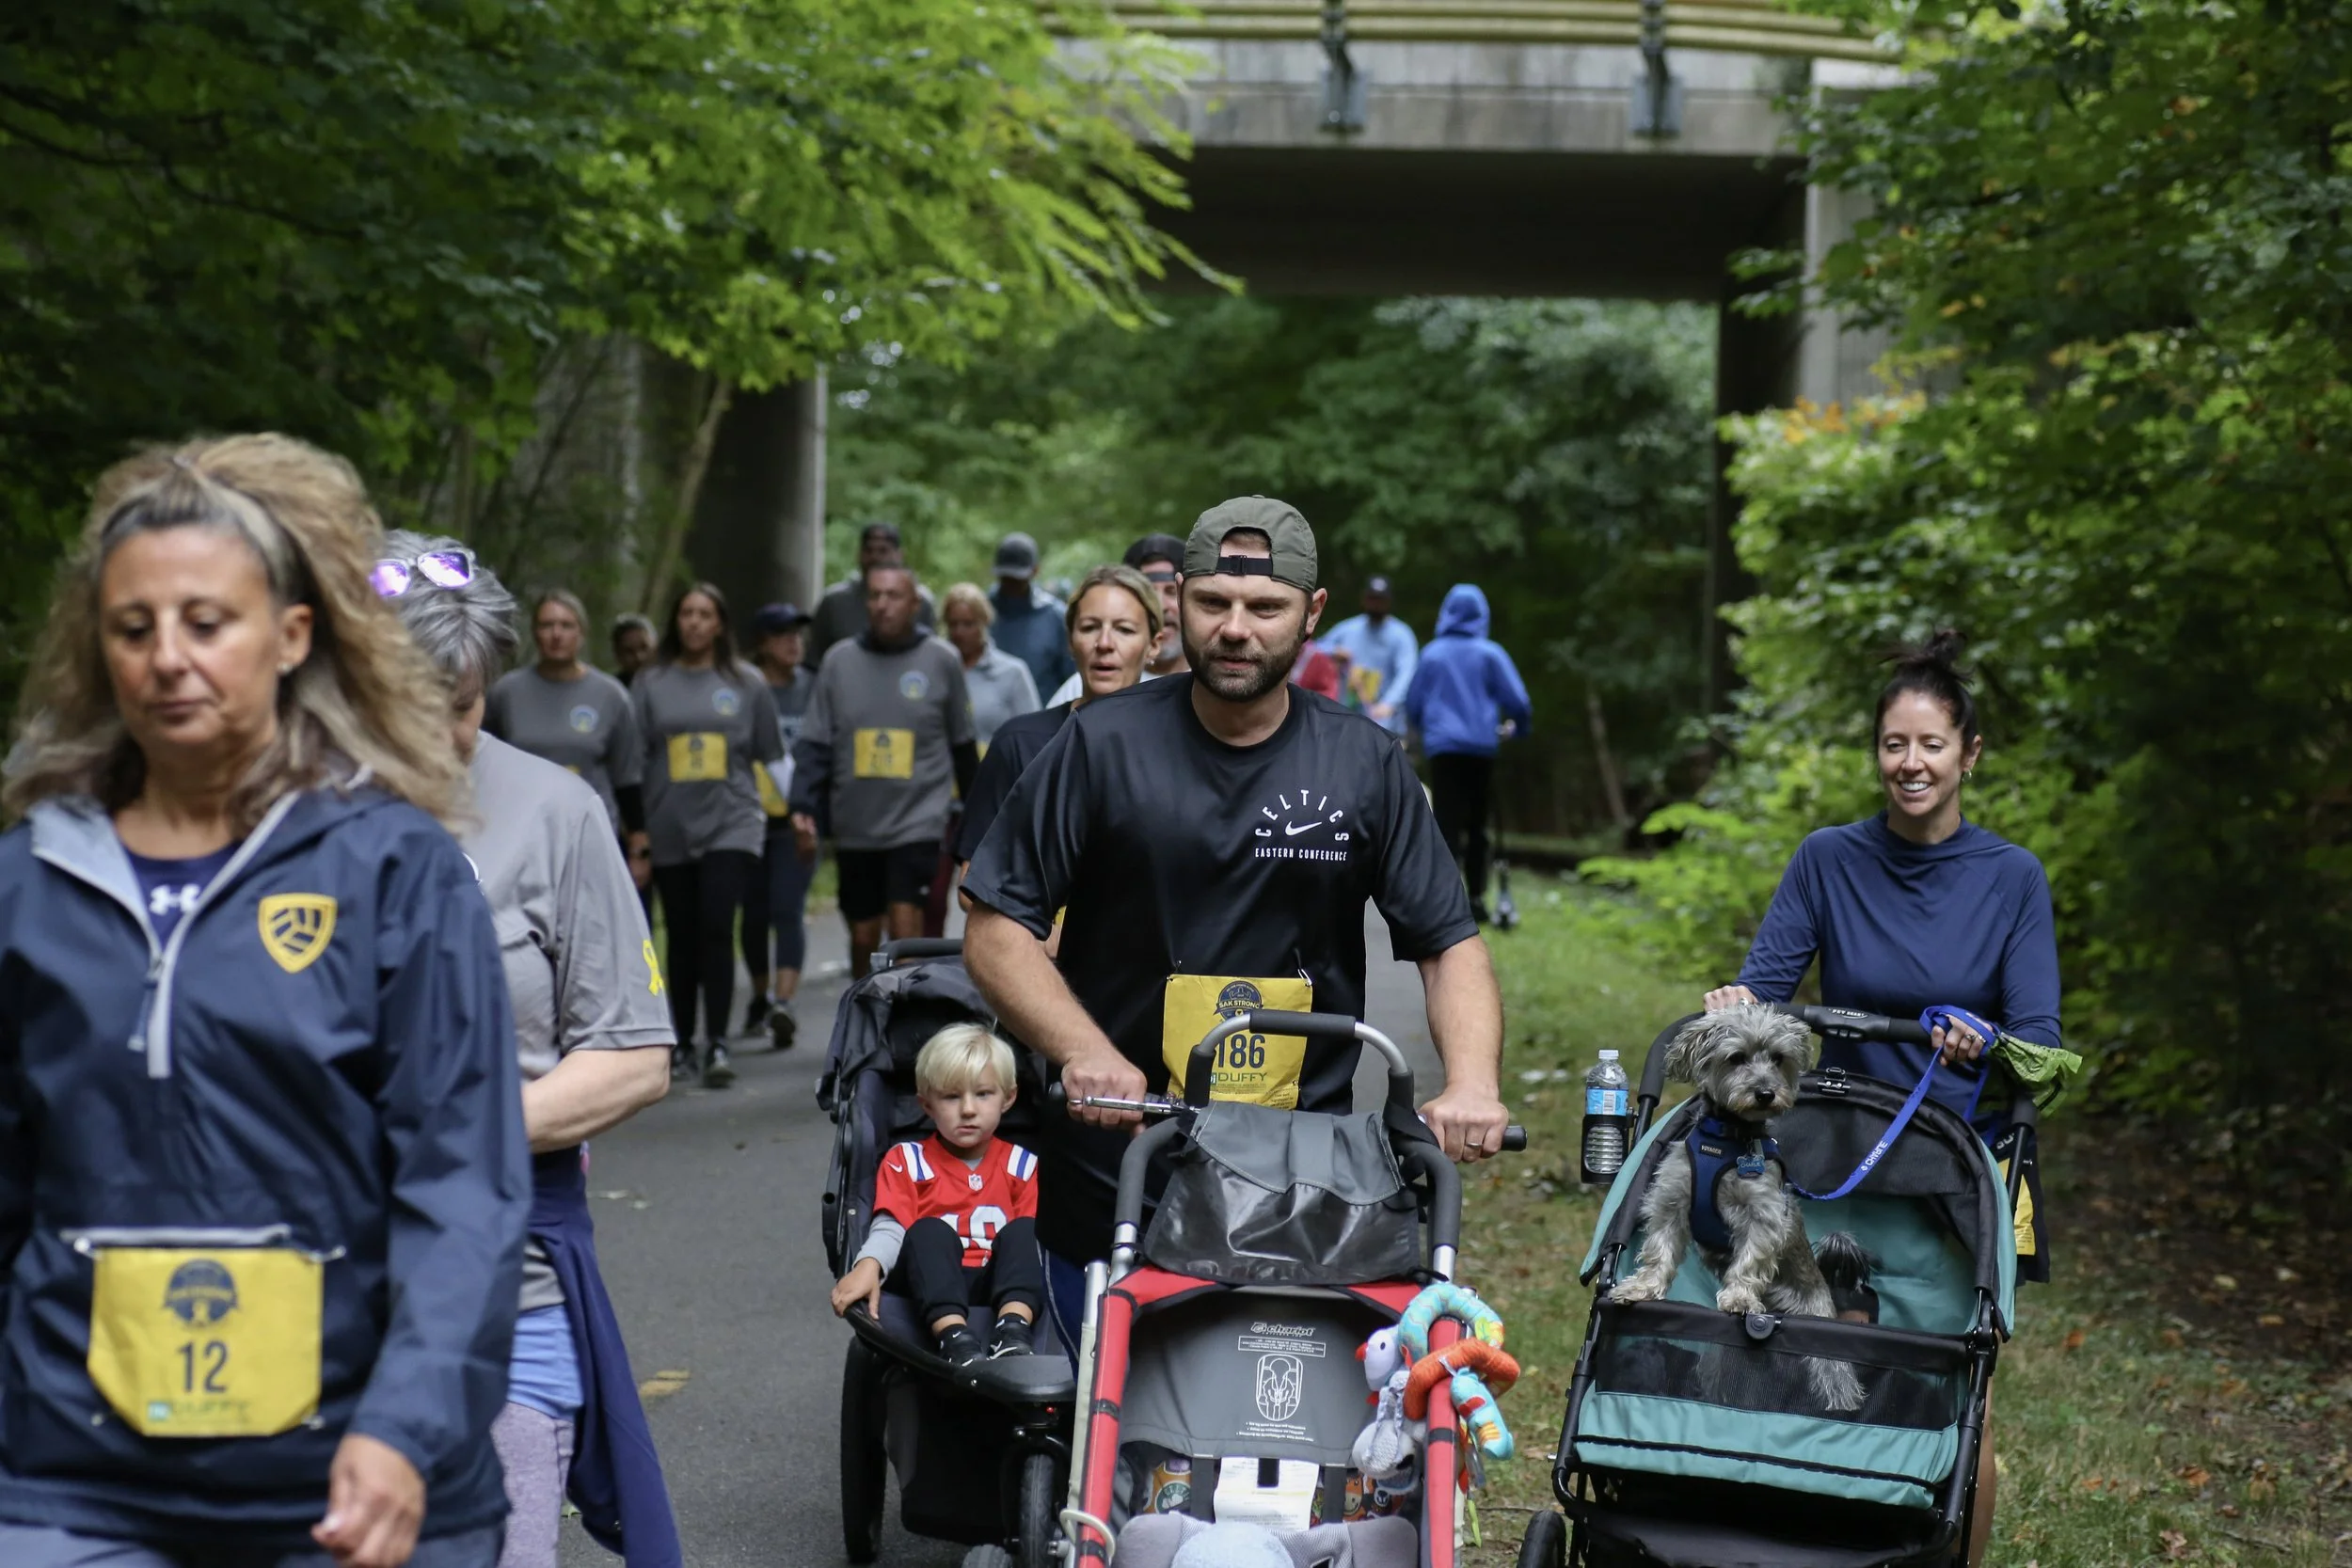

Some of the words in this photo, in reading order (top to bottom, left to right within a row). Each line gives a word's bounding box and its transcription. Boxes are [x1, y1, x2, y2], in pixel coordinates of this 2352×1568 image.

[1254, 789, 1350, 841] CELTICS
[1255, 847, 1294, 858] EASTERN
[1298, 848, 1347, 861] CONFERENCE
[1217, 1034, 1265, 1069] 186
[1218, 1072, 1267, 1083] DUFFY
[178, 1339, 229, 1394] 12
